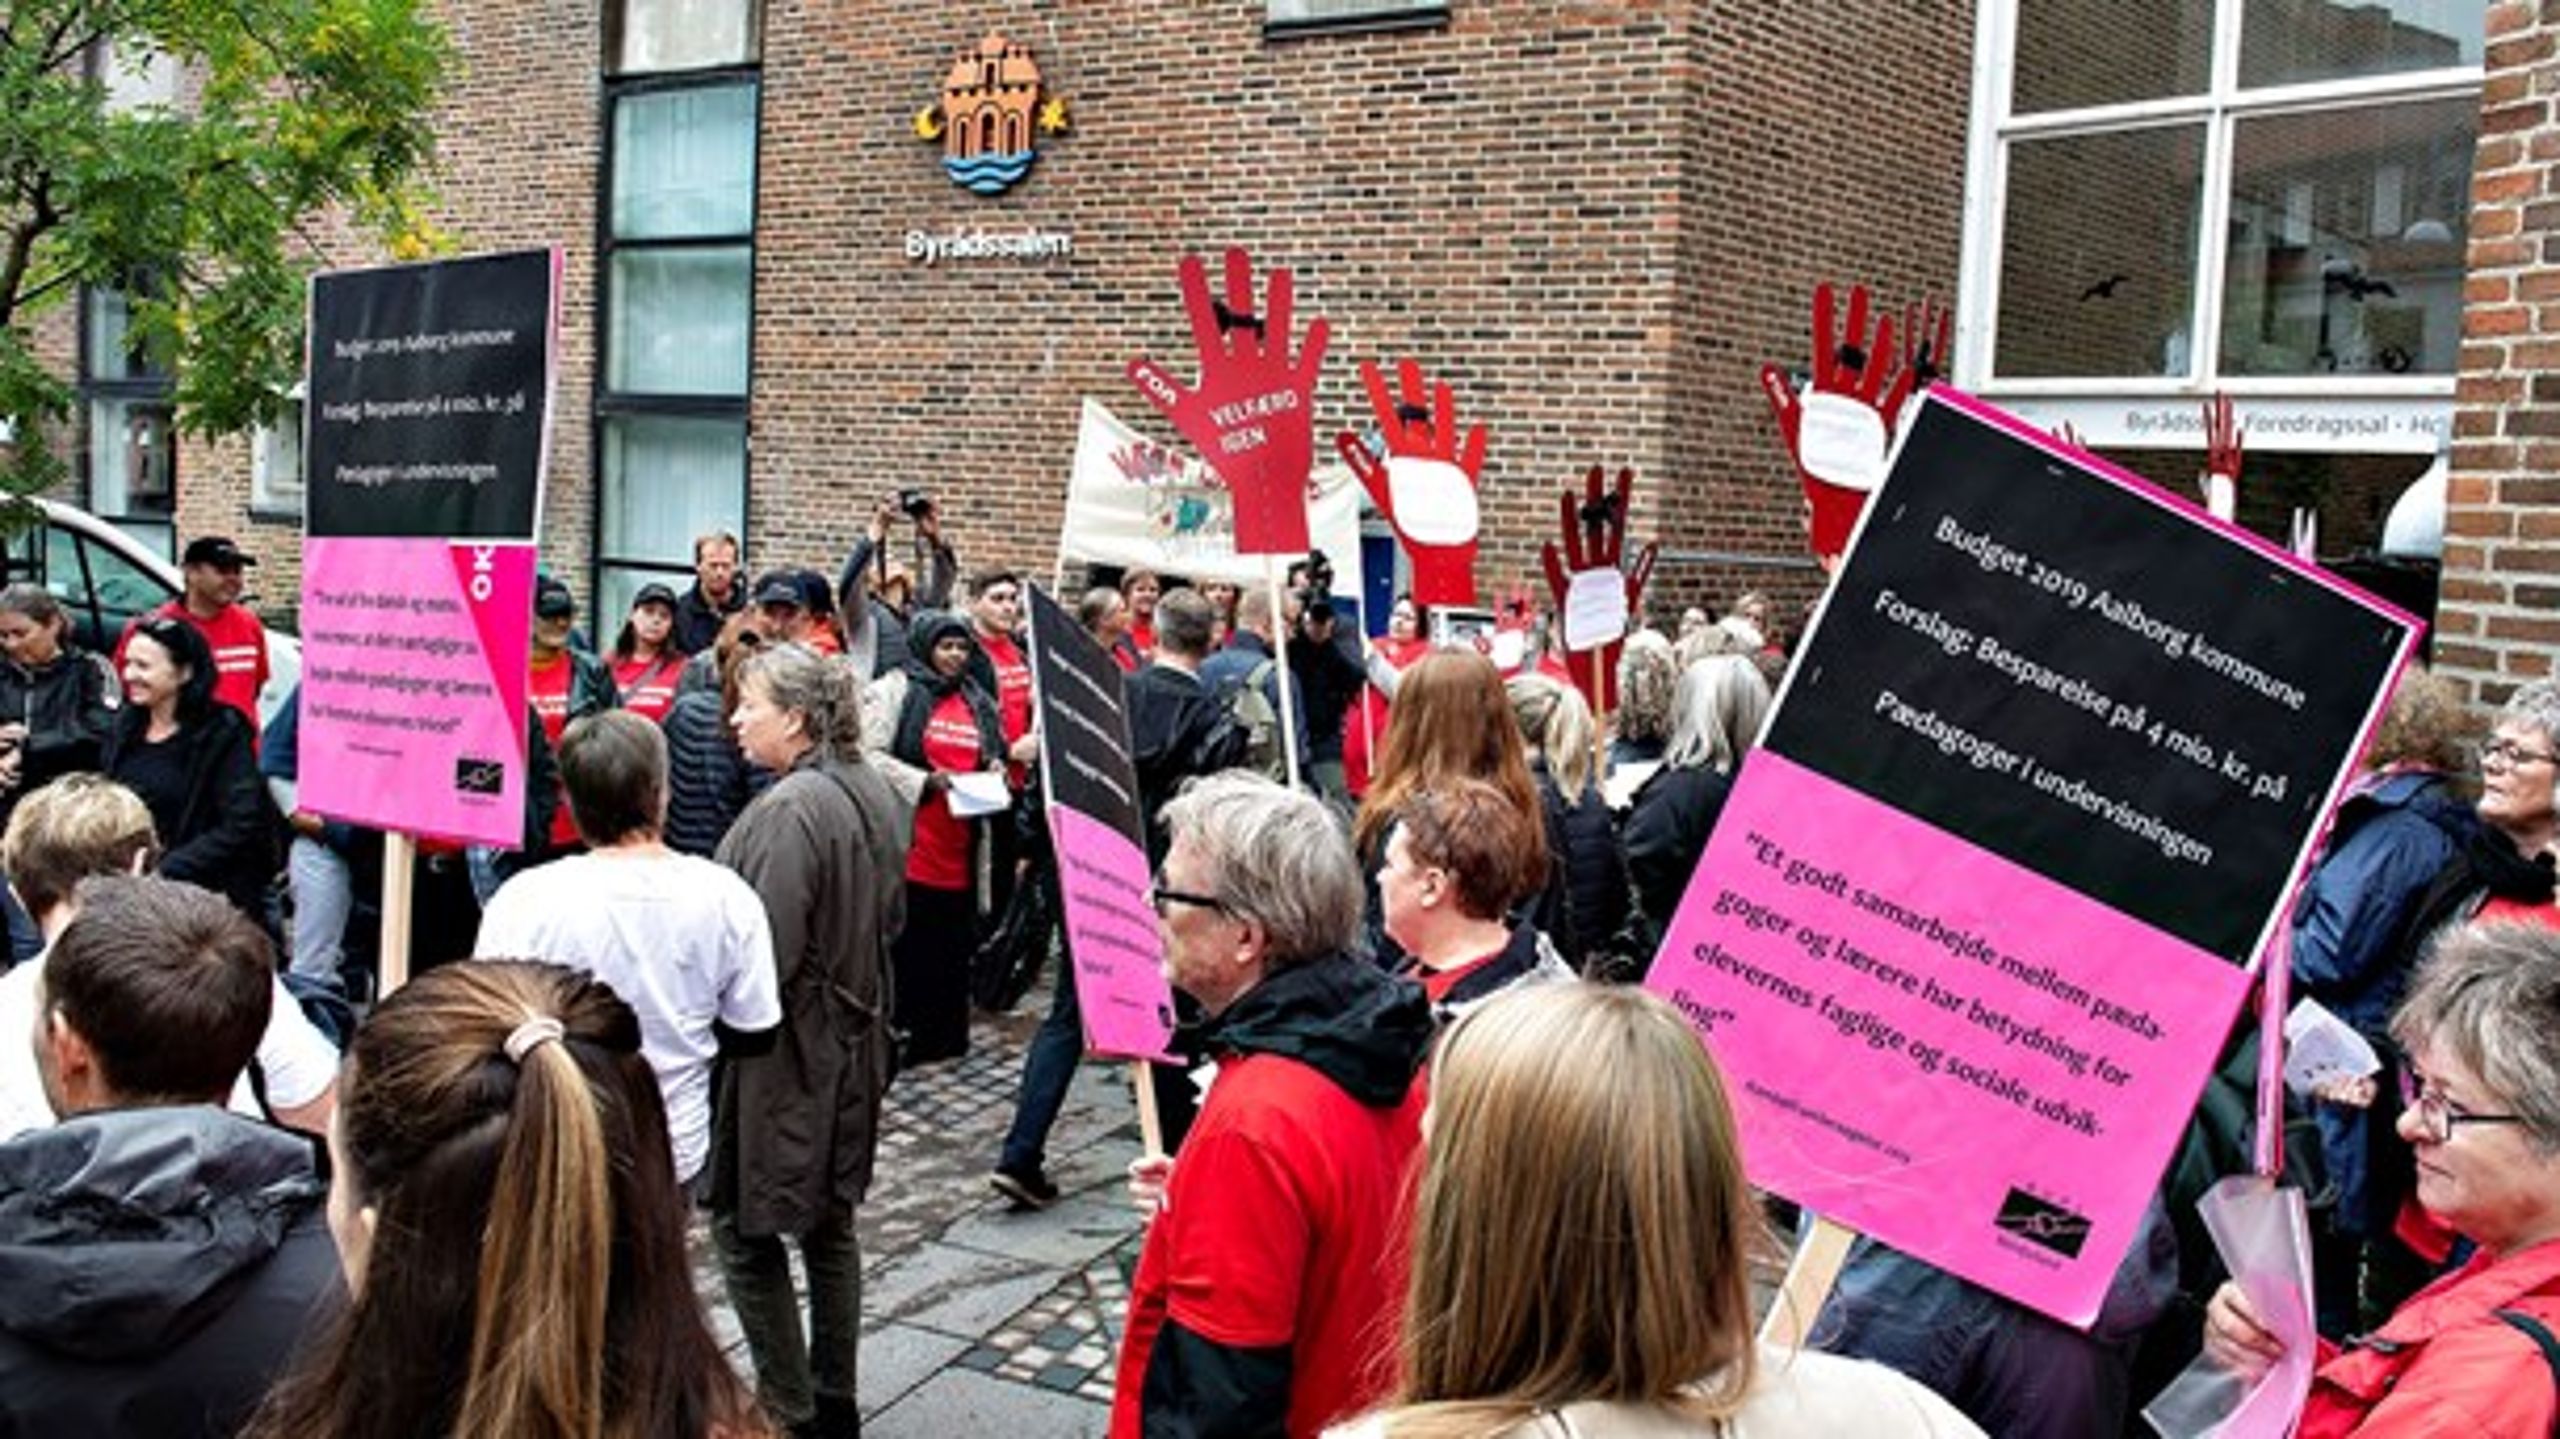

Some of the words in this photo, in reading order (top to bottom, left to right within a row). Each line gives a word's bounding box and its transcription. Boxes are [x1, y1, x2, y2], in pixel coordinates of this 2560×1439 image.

[905, 226, 1073, 265] Byrådssalen
[2126, 410, 2204, 436] Byrådss
[2244, 410, 2389, 438] Foredragssal
[1874, 590, 1976, 656] Forslag:
[1976, 636, 2112, 716] Besparelse
[2110, 703, 2146, 733] på
[2146, 721, 2163, 745] 4
[2165, 731, 2217, 769] mio.
[2220, 751, 2251, 785] kr.
[2251, 774, 2288, 802] på
[1935, 516, 2028, 573] Budget
[2029, 563, 2088, 608] 2019
[2089, 591, 2190, 658] Aalborg
[2190, 633, 2306, 710] kommune
[1874, 690, 2021, 775] Pædagoger
[2021, 757, 2034, 780] i
[2033, 764, 2213, 866] undervisningen
[1693, 941, 1815, 1009] elevernes
[1817, 994, 1906, 1050] faglige
[1907, 1040, 1943, 1074] og
[1945, 1056, 2030, 1108] sociale
[2032, 1097, 2104, 1137] udvik-
[1711, 889, 1794, 934] goger
[1796, 926, 1833, 960] og
[1833, 938, 1919, 994] lærere
[1921, 978, 1965, 1013] har
[1966, 998, 2090, 1077] betydning
[2092, 1056, 2133, 1088] for
[1783, 859, 1848, 898] godt
[1851, 887, 1997, 966] samarbejde
[1999, 954, 2090, 1008] mellem
[2089, 997, 2166, 1041] pæda-
